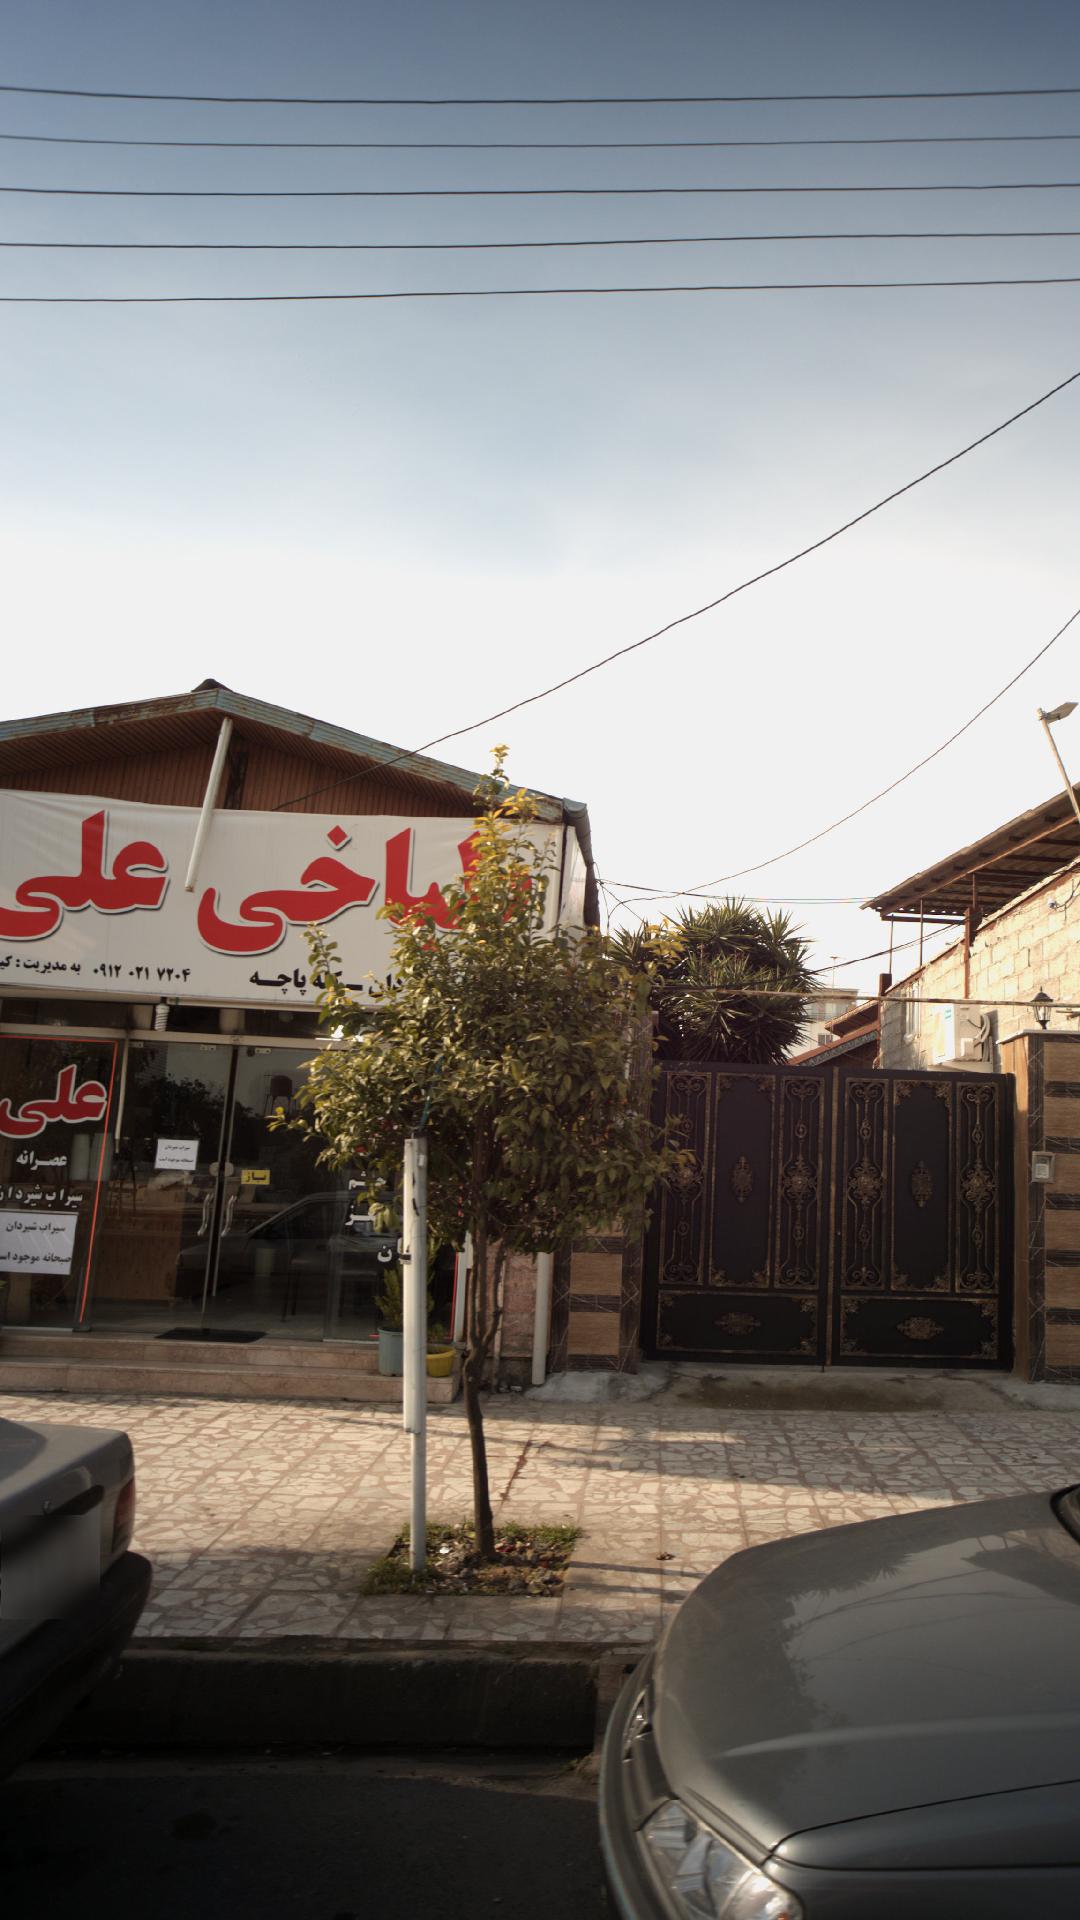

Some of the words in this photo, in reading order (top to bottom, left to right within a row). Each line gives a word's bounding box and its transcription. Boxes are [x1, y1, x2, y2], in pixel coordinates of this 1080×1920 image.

[0, 810, 168, 941] علی
[23, 960, 67, 974] مدیریت
[70, 961, 81, 975] به
[93, 963, 122, 978] ۰۹۱۲
[249, 968, 306, 996] پاچه
[0, 1063, 108, 1139] علی
[16, 1149, 68, 1171] عصرانه
[245, 1171, 267, 1183] باز
[5, 1220, 38, 1233] شیردان
[39, 1222, 66, 1234] سیراب
[12, 1252, 41, 1264] موجود
